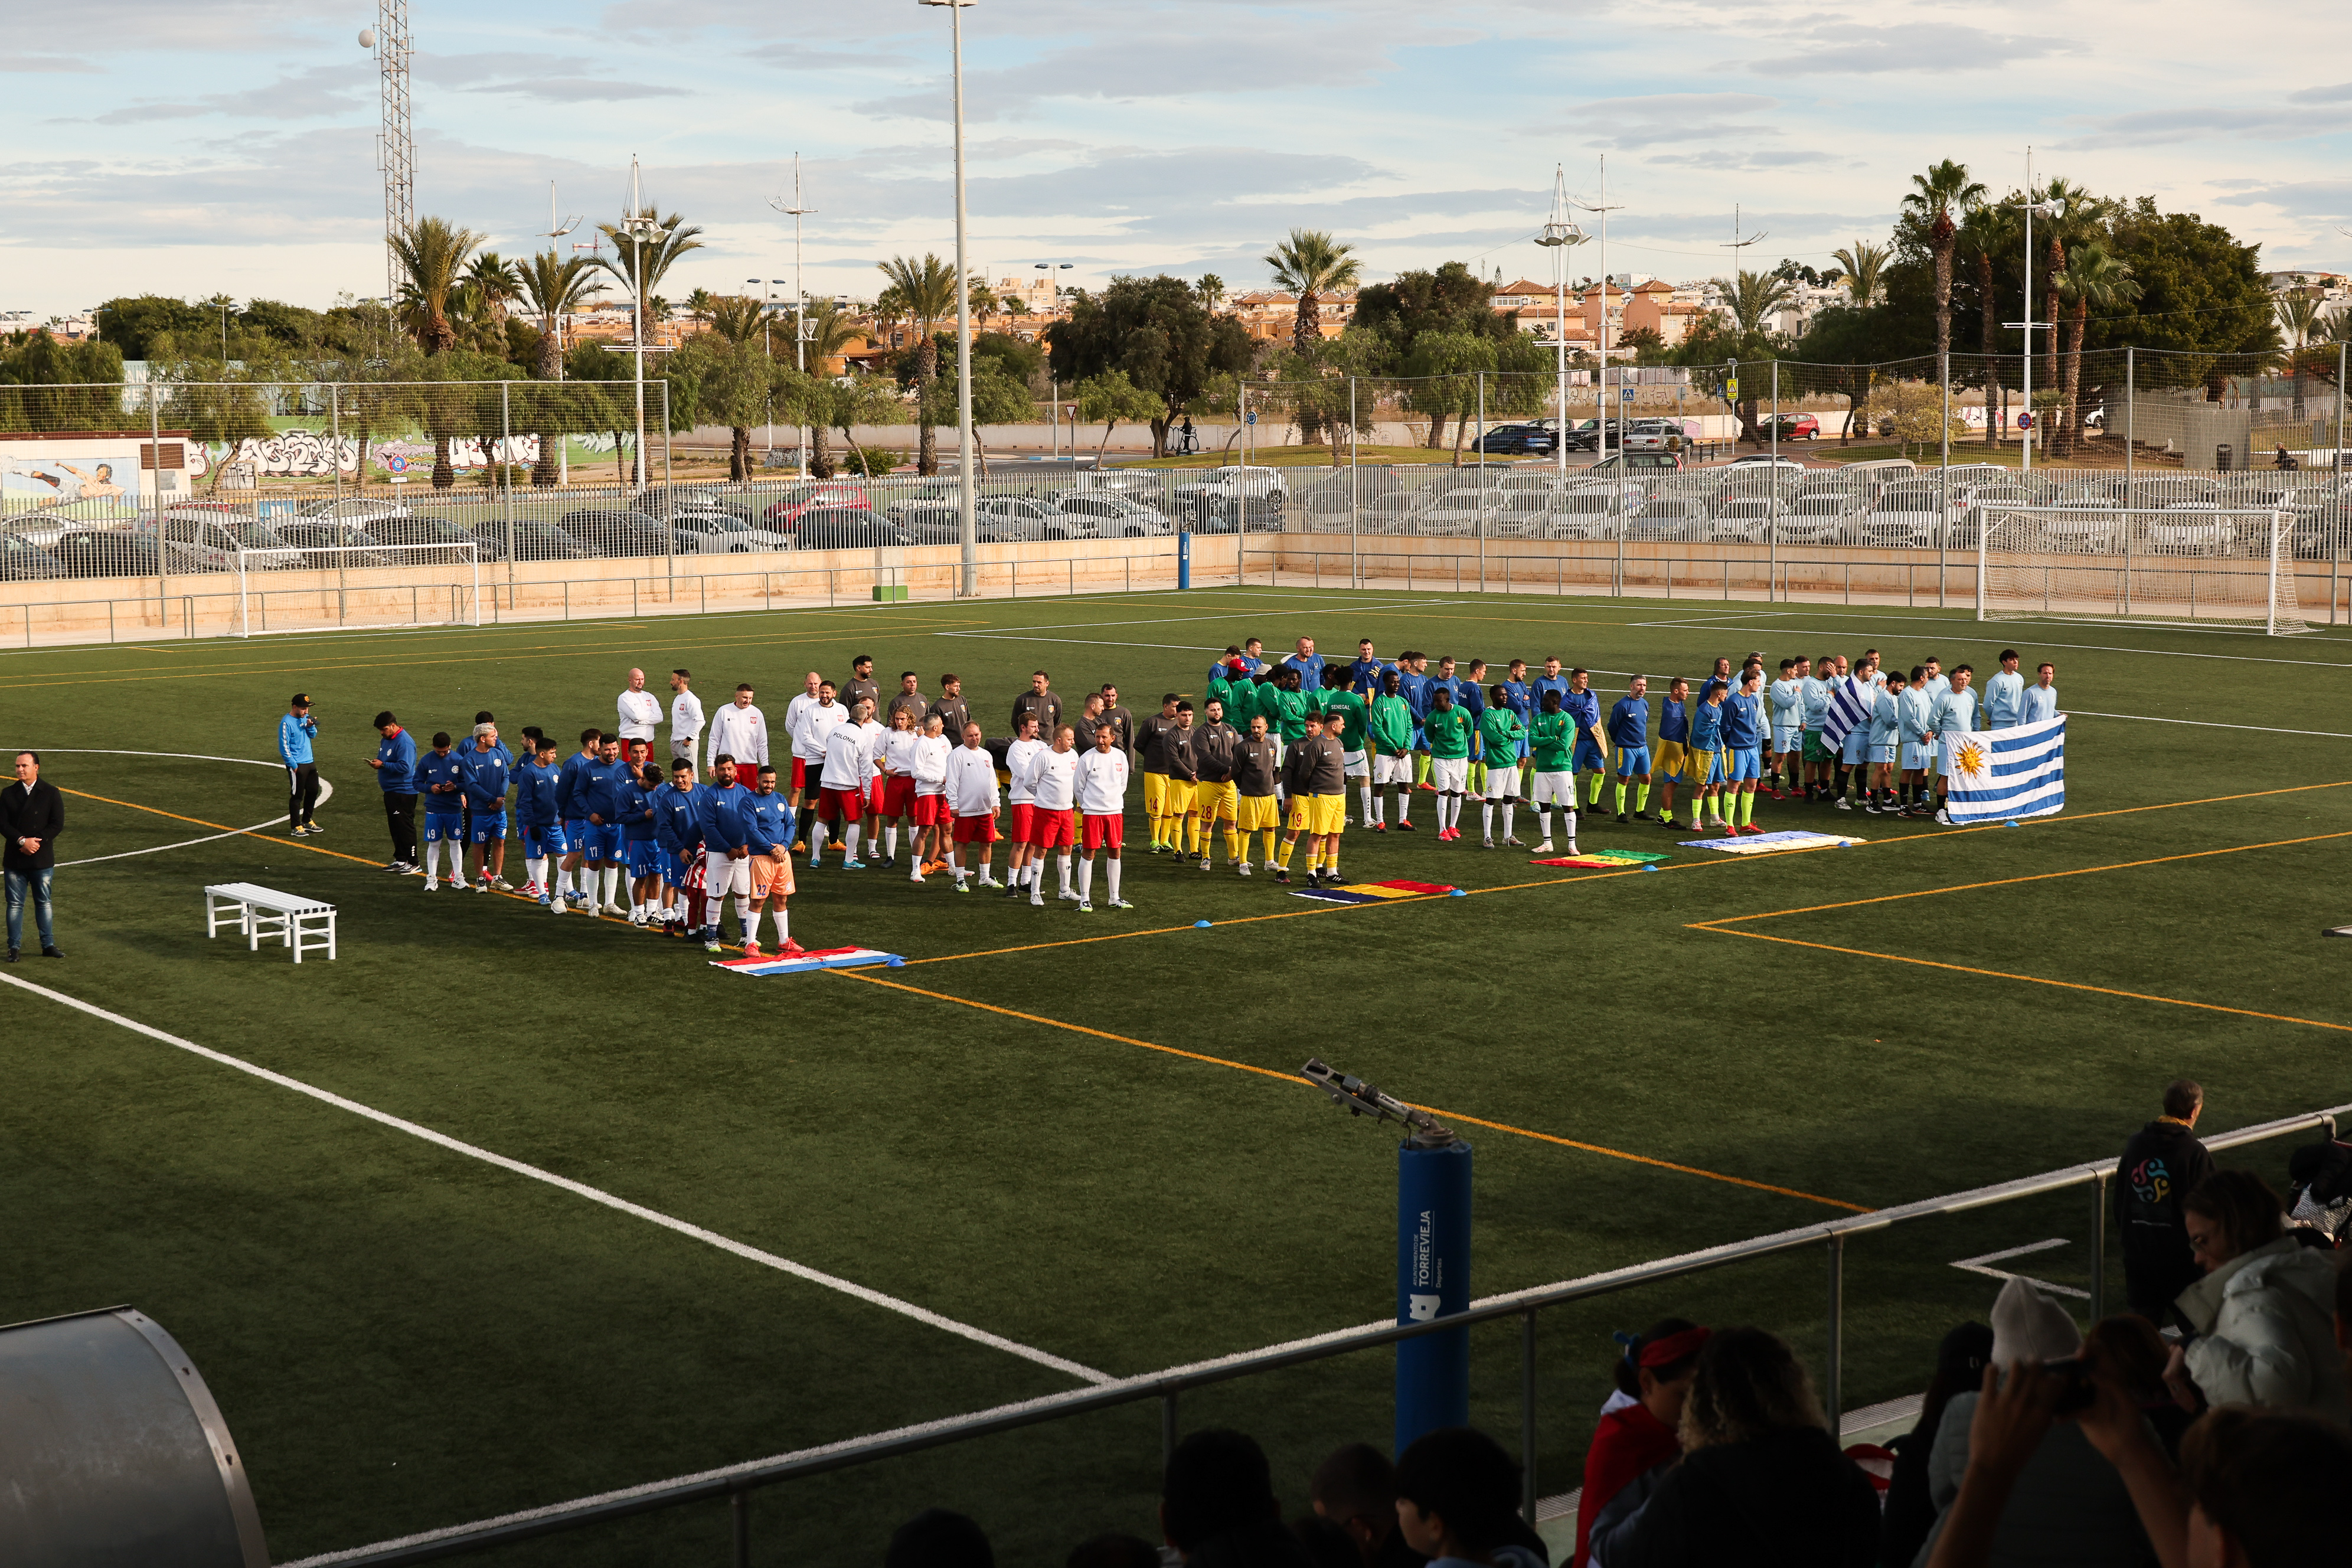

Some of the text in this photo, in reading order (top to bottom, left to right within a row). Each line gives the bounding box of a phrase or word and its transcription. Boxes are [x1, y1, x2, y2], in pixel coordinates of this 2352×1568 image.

[833, 732, 855, 745] POLONIA
[1149, 797, 1158, 812] 14
[1201, 804, 1212, 819] 28
[1291, 812, 1302, 828] 19
[427, 829, 436, 839] 49
[478, 831, 485, 841] 10
[537, 844, 541, 855] 8
[574, 838, 583, 850] 19
[589, 846, 598, 857] 17
[638, 864, 646, 875] 11
[716, 882, 720, 894] 1
[757, 884, 767, 896] 22
[1413, 1233, 1419, 1242] DE
[1419, 1210, 1430, 1287] TORREVIEJA
